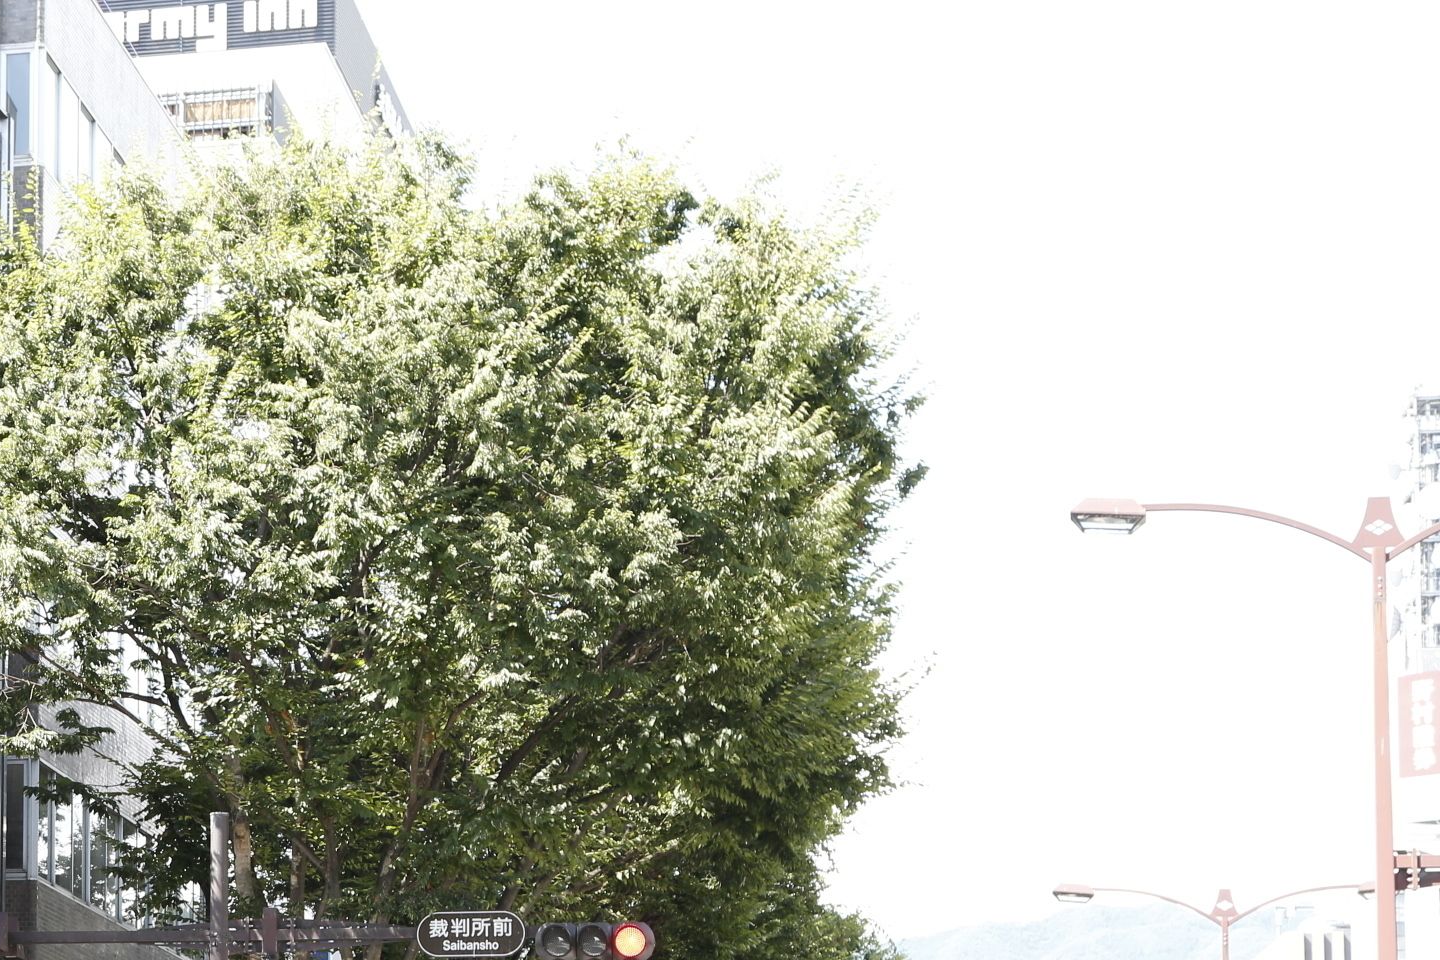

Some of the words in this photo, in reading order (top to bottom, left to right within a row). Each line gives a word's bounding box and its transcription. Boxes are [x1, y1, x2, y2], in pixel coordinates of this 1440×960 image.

[104, 3, 227, 51] rmy
[429, 917, 513, 938] 裁判所前
[442, 940, 500, 951] Saibansho
